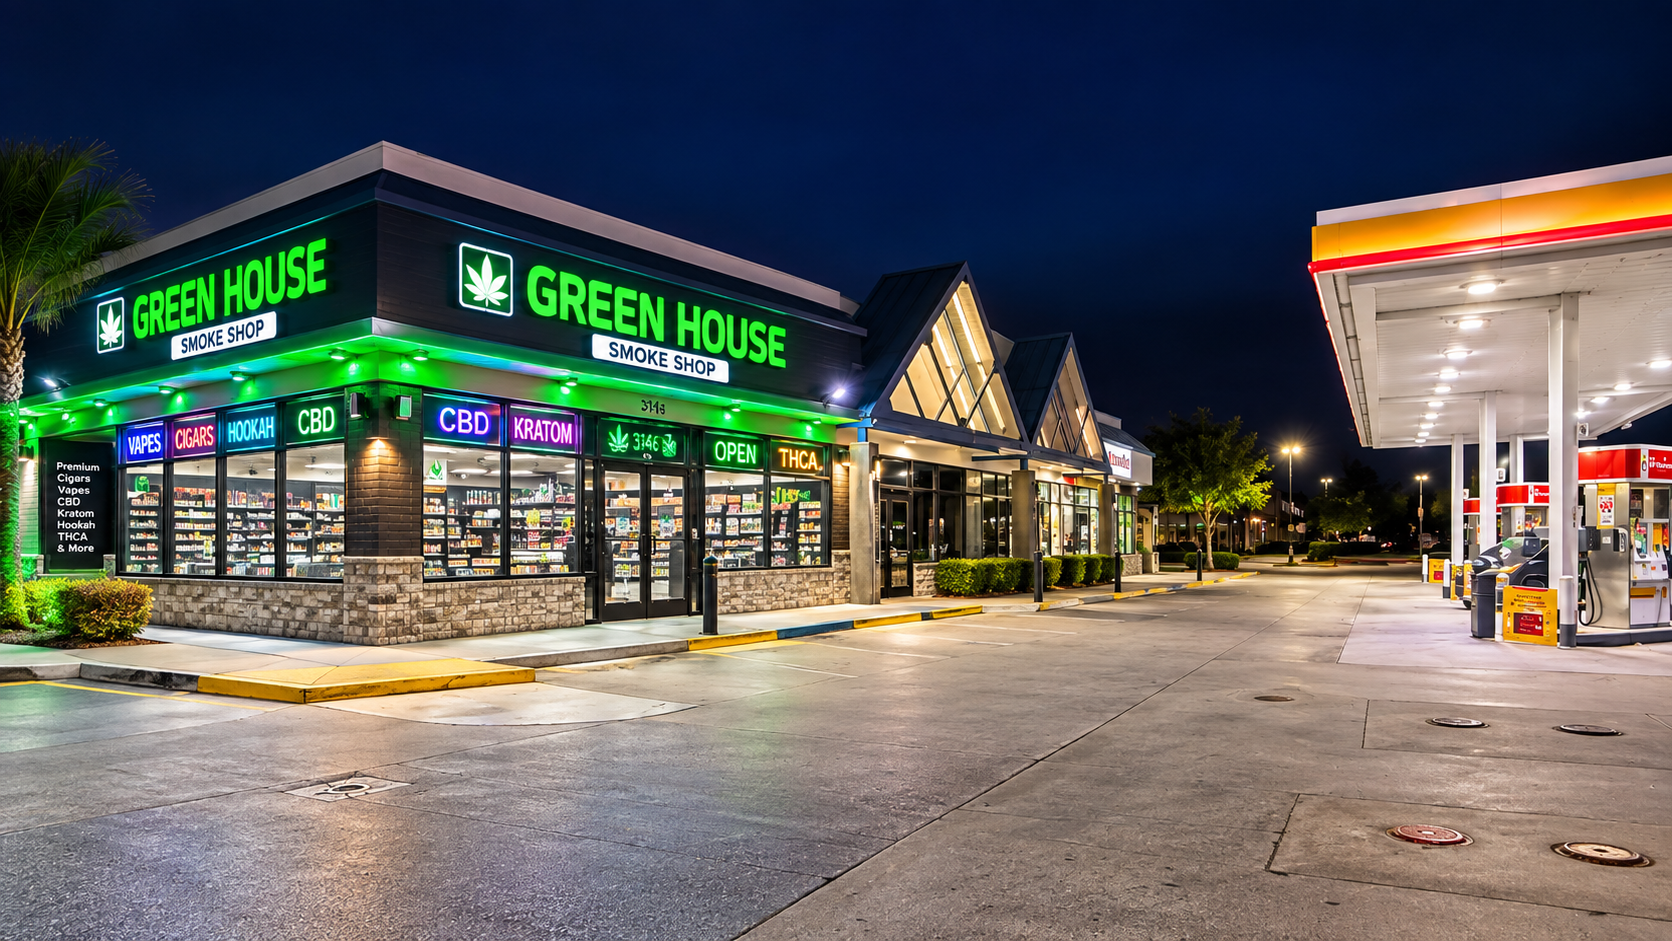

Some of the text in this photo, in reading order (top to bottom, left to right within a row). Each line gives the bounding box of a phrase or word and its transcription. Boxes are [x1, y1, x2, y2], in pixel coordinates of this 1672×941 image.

[132, 237, 327, 339] GREEN HOUSE
[526, 264, 787, 369] GREEN HOUSE
[181, 319, 265, 354] SMOKE SHOP
[608, 341, 716, 377] SMOKE SHOP
[227, 416, 275, 443] HOOKAH
[298, 406, 335, 435] CBD
[439, 406, 490, 436] CBD
[513, 416, 573, 445] KRATOM
[127, 432, 162, 455] VAPES
[174, 425, 214, 450] CIGARS
[714, 440, 757, 465] OPEN
[56, 461, 100, 472] Premium
[57, 485, 91, 496] Vapes
[57, 497, 81, 507] CBD
[57, 508, 95, 518] Kratom
[57, 520, 96, 530] Hookah
[57, 532, 88, 541] THCA
[57, 543, 95, 553] & More
